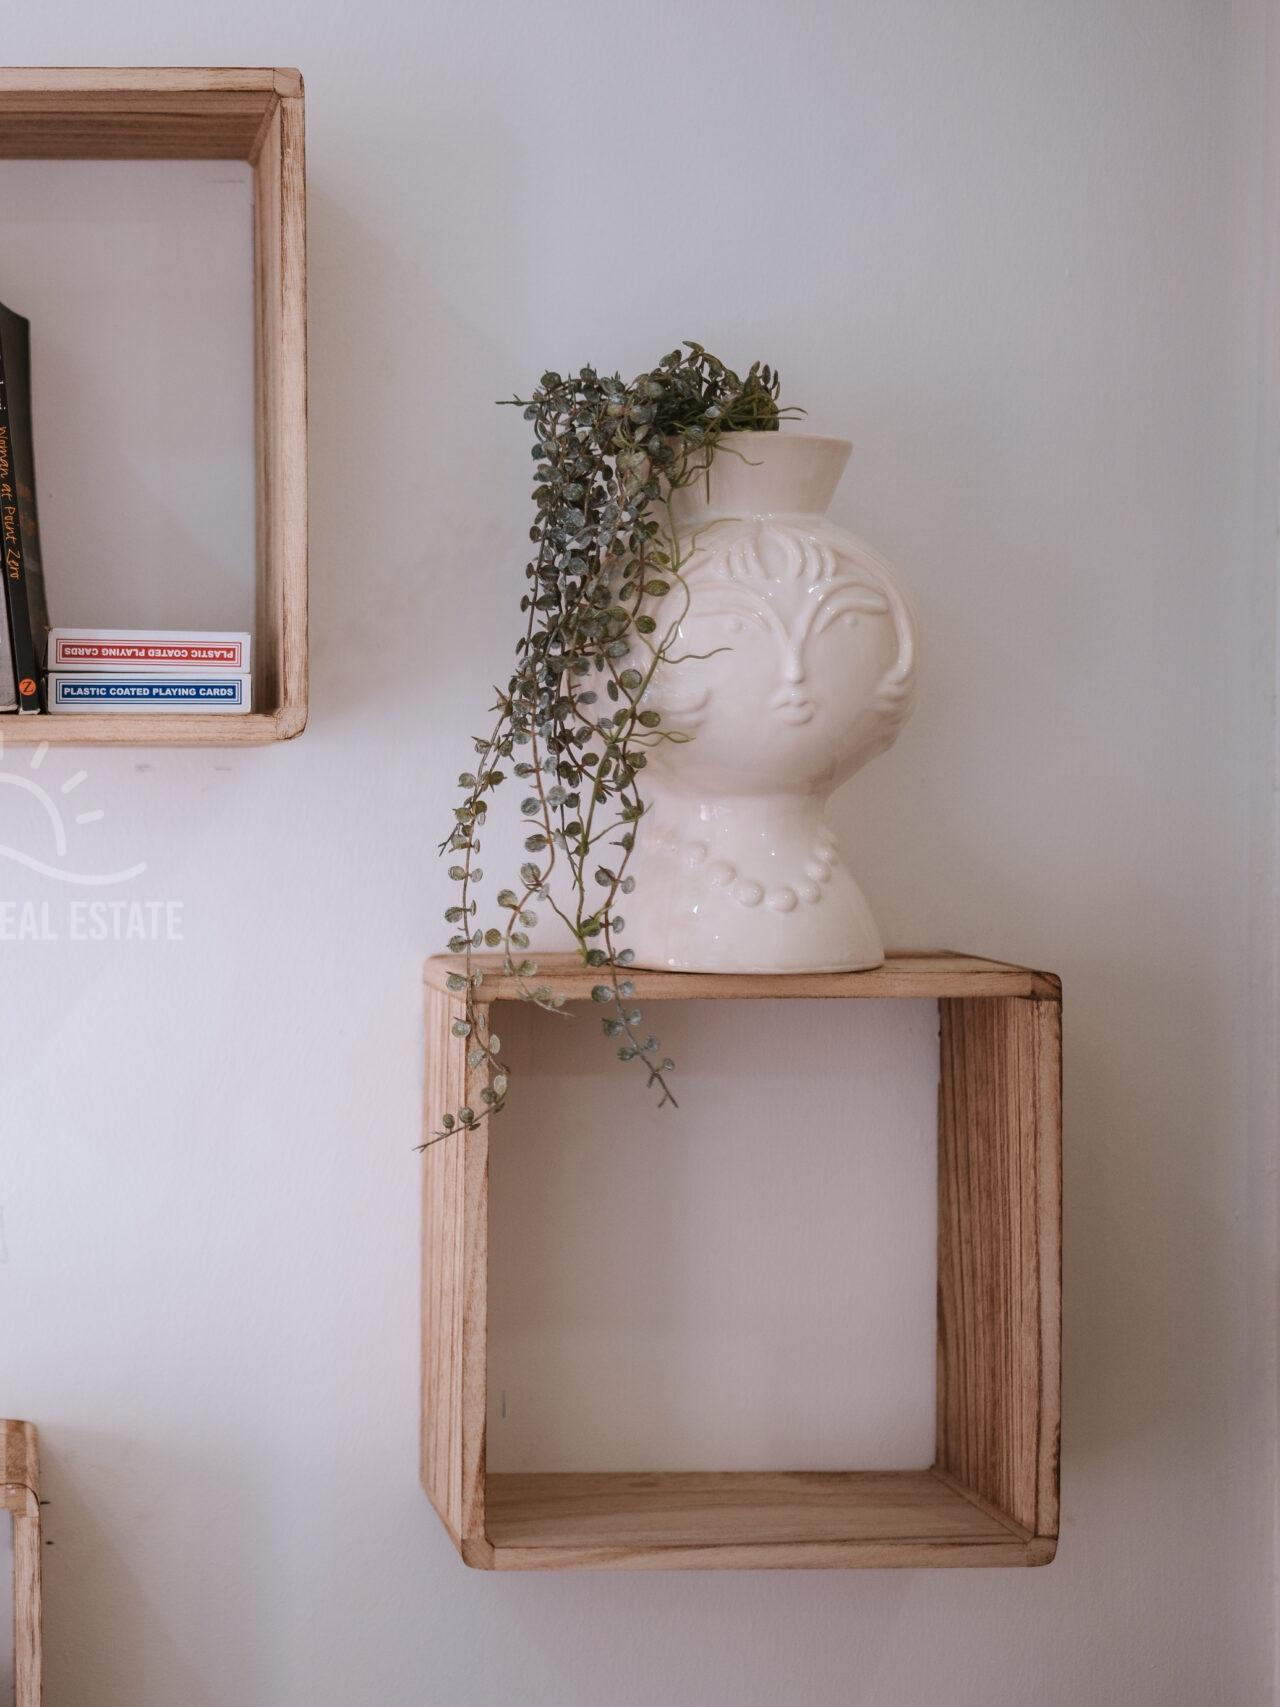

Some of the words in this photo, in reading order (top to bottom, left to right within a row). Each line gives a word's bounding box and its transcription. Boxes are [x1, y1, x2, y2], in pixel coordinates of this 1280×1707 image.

[1, 483, 12, 500] at
[4, 506, 17, 544] Point
[6, 548, 21, 580] Zero
[64, 647, 98, 656] CARDS
[102, 648, 145, 656] PLAYING
[148, 649, 187, 657] COATED
[191, 650, 234, 658] PLASTIC
[64, 688, 107, 696] PLASTIC
[109, 688, 150, 696] COATED
[152, 688, 197, 696] PLAYING
[199, 688, 234, 696] CARDS
